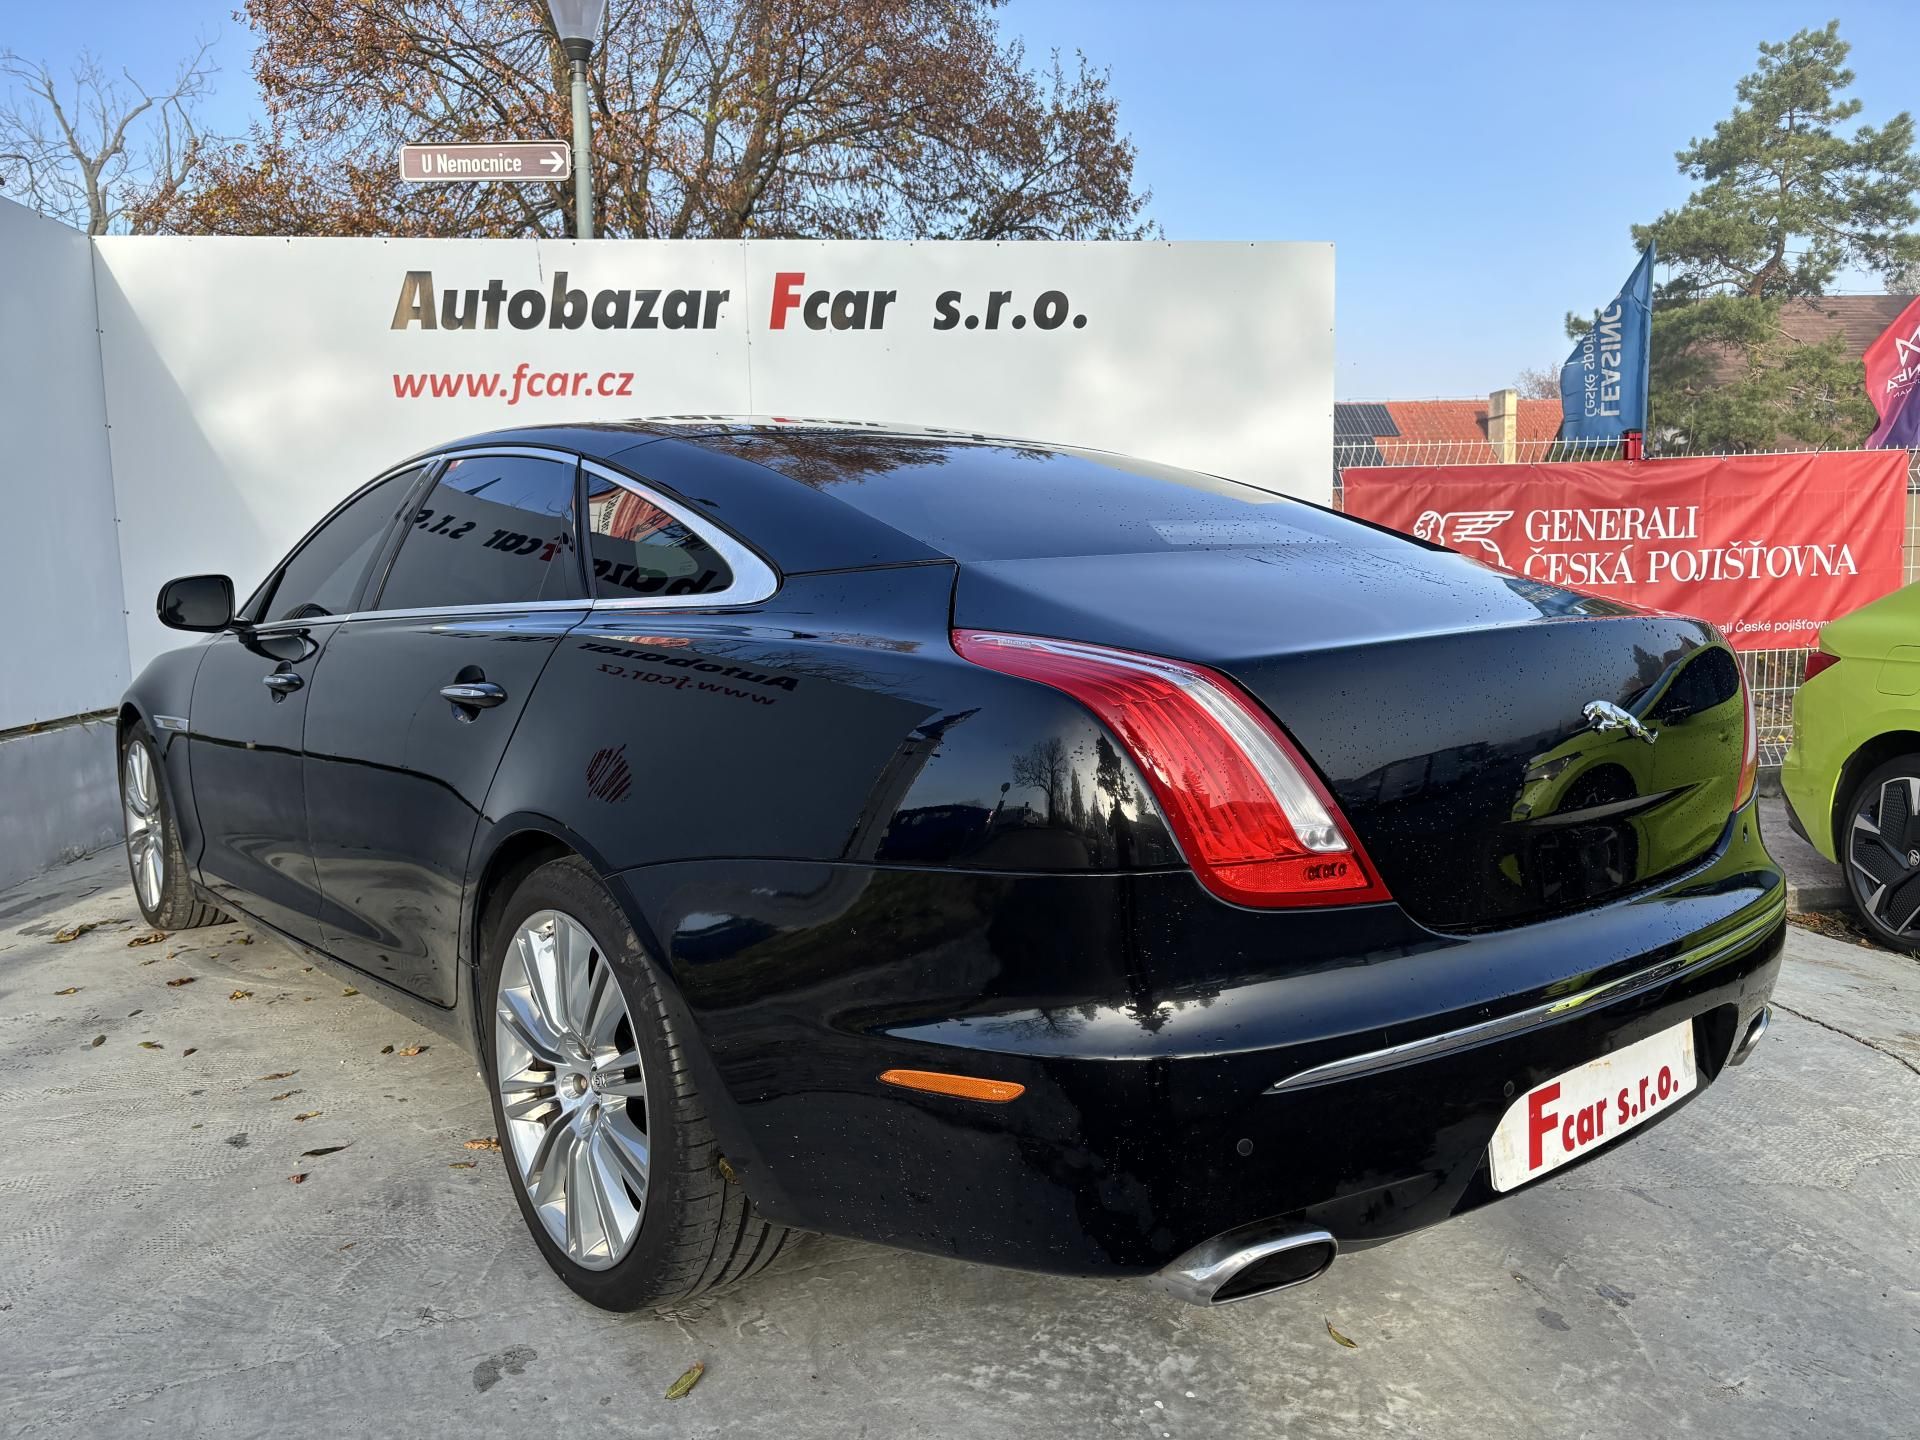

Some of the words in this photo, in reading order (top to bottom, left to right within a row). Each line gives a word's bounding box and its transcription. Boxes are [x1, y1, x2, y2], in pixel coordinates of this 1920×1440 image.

[421, 154, 432, 173] U
[437, 152, 522, 173] Nemocnice
[390, 270, 731, 330] Autobazar
[769, 272, 897, 331] Fcar
[933, 290, 1088, 331] s.r.o.
[393, 363, 635, 405] www.fcar.cz
[1525, 506, 1699, 543] GENERALI
[1523, 545, 1636, 586] ČESKÁ
[1646, 540, 1858, 584] POJIŠŤOVNA
[1735, 619, 1771, 633] České
[1528, 1081, 1608, 1171] Fcar
[1617, 1065, 1679, 1126] s.r.o.
